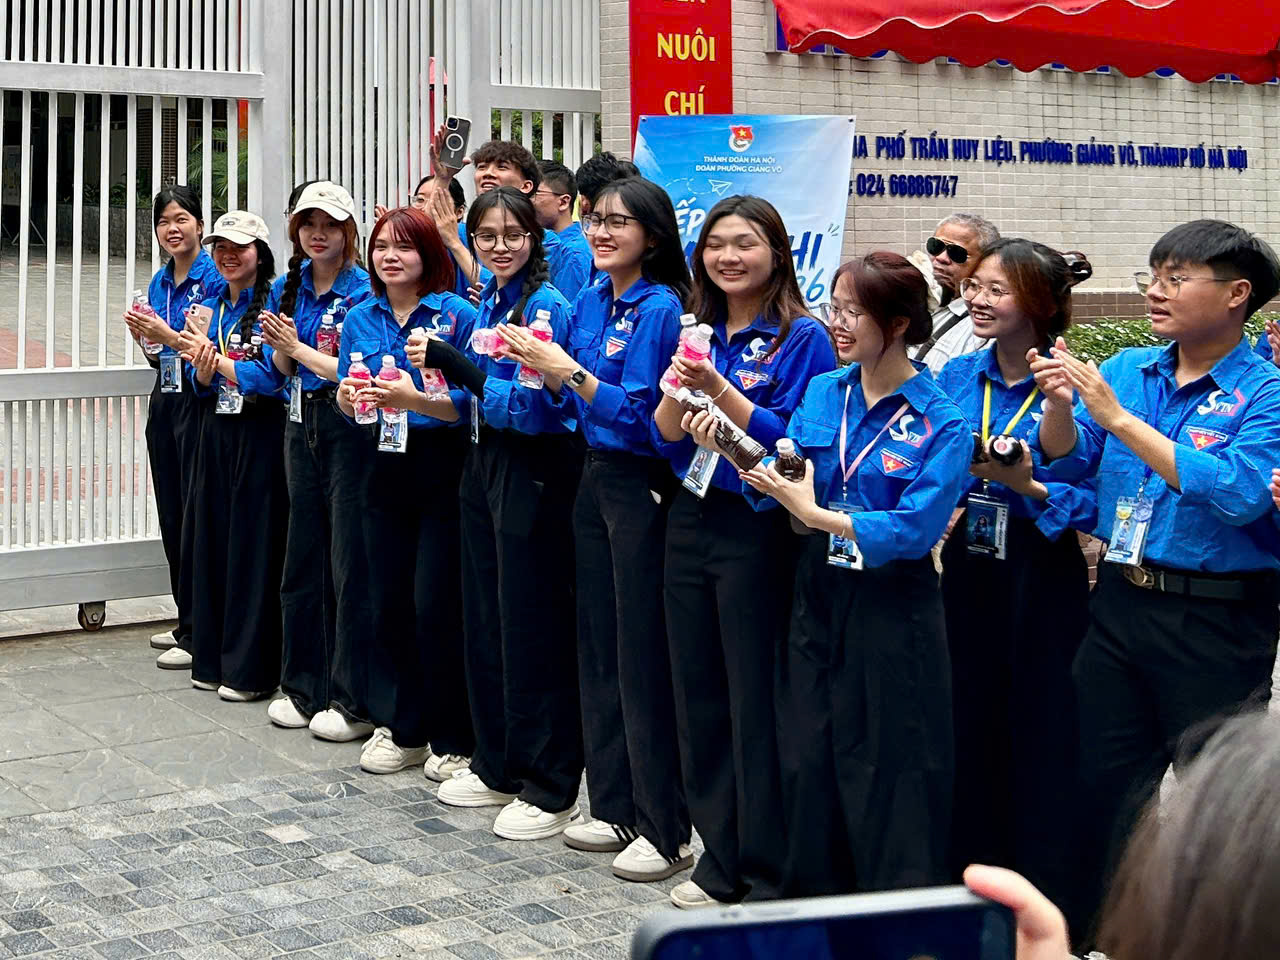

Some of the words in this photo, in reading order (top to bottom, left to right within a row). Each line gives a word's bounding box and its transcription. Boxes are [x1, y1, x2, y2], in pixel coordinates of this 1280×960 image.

[657, 27, 716, 61] NUÔI
[664, 85, 705, 116] CHÍ
[875, 129, 907, 160] PHỐ
[952, 138, 980, 161] HUY
[856, 173, 885, 197] 024
[675, 197, 707, 236] ẾP
